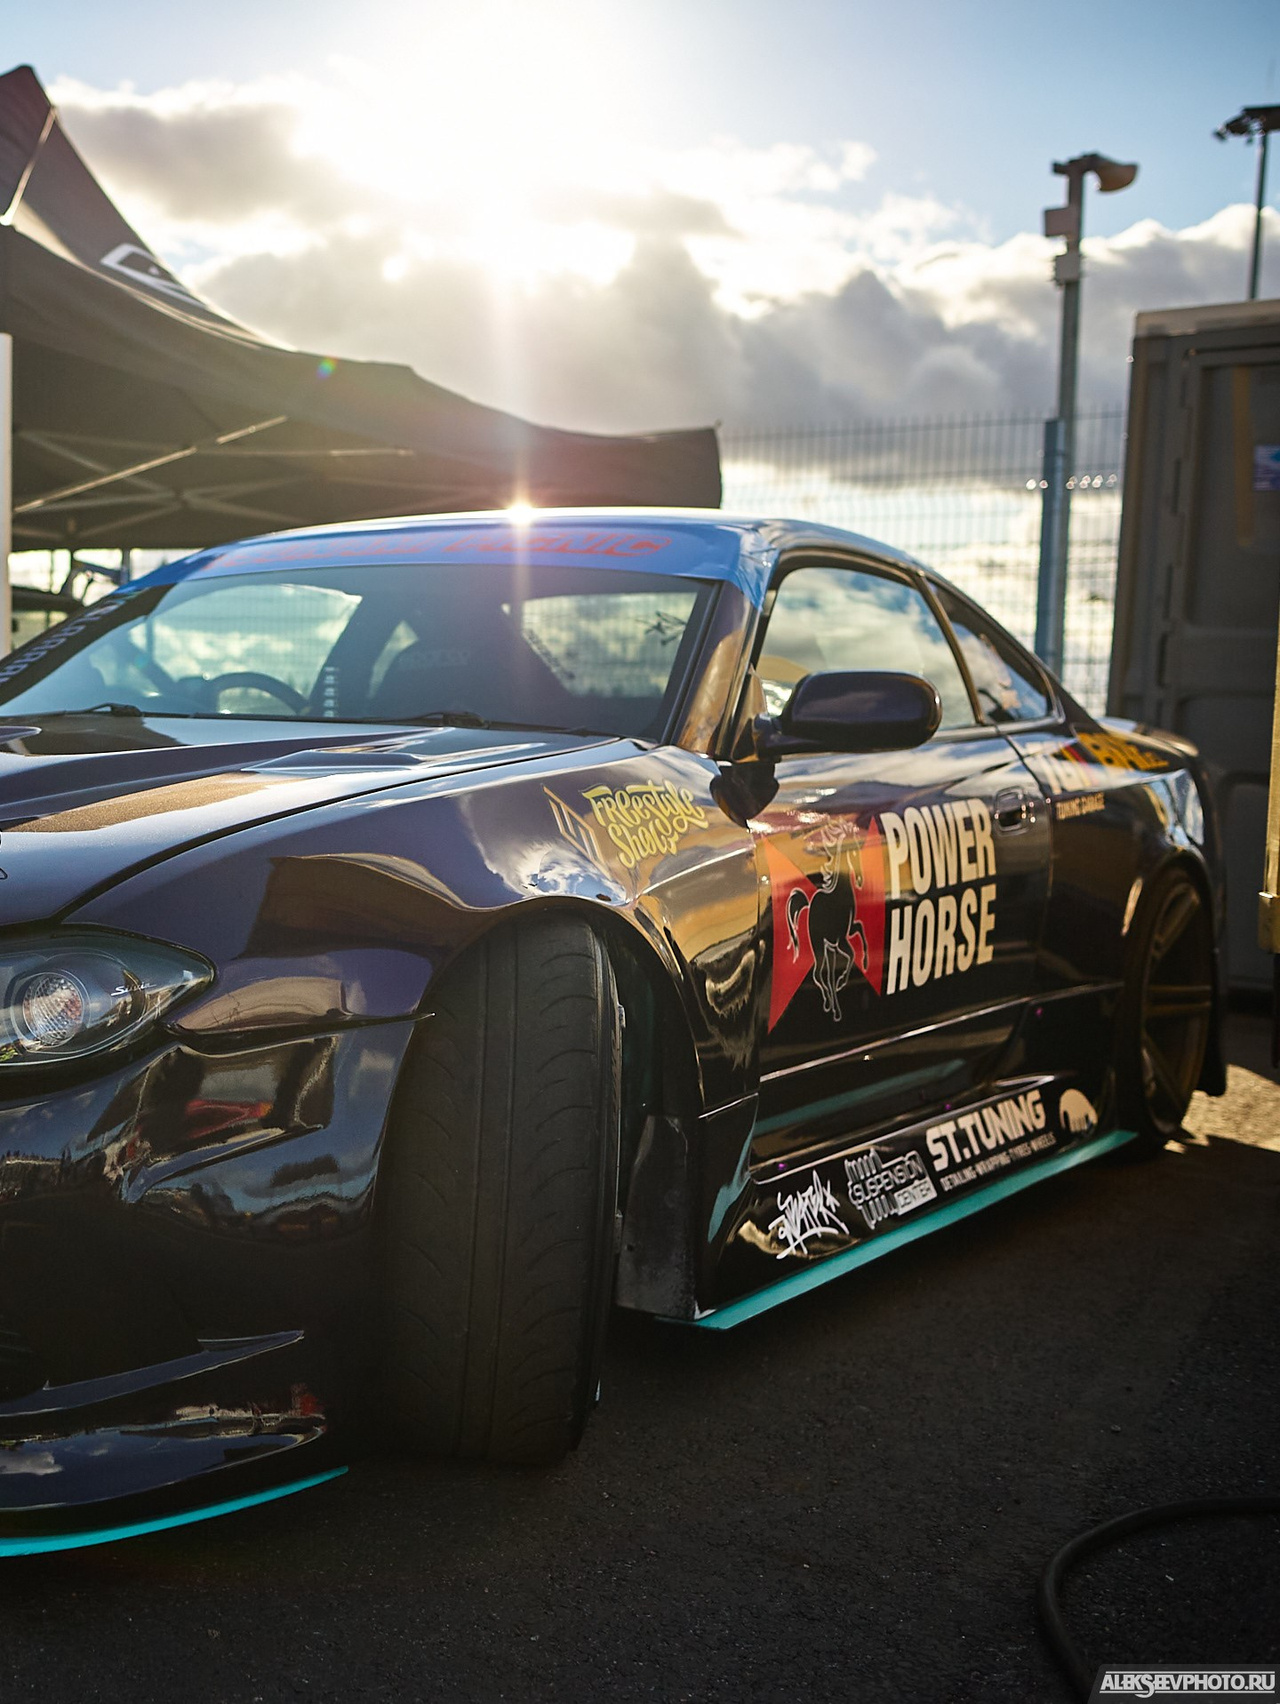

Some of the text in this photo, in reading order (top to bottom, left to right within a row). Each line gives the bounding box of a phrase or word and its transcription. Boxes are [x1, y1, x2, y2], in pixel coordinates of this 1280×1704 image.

[880, 798, 996, 899] POWER
[886, 884, 997, 995] HORSE
[925, 1089, 1047, 1172] ST.TUNING
[852, 1158, 926, 1204] SUSPENSION
